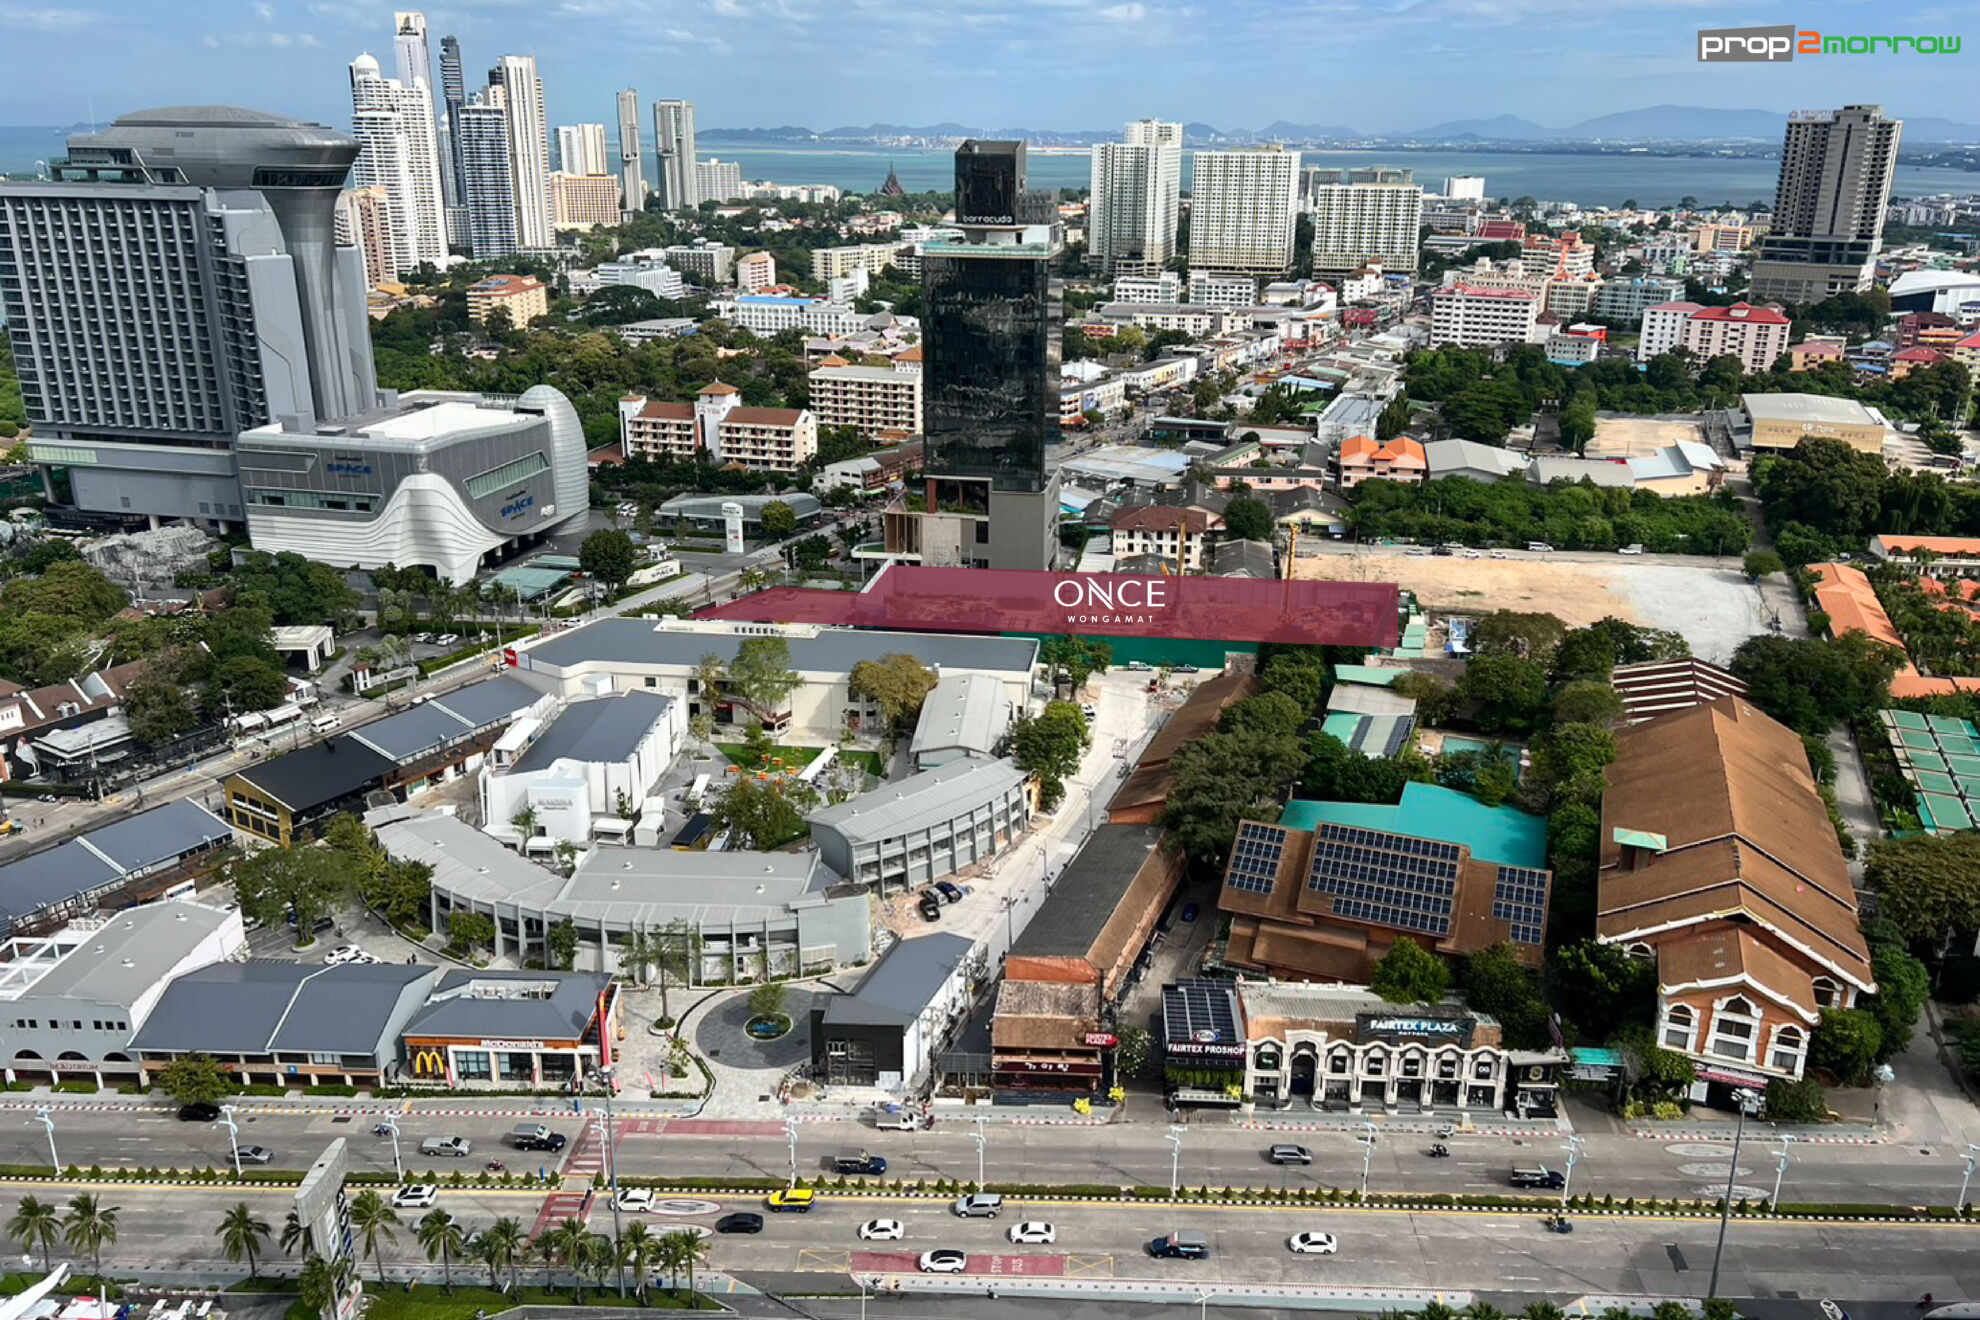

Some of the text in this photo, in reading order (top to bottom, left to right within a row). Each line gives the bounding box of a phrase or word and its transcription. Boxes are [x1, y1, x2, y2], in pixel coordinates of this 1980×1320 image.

[962, 215, 1012, 224] barracuda
[1370, 1019, 1458, 1033] FAIRTEX PLAZA
[1085, 1038, 1107, 1046] PLAZA
[1168, 1043, 1245, 1056] FAIRTEX PROSHOP
[991, 1255, 1003, 1274] STOP
[1011, 1258, 1023, 1273] BUS
